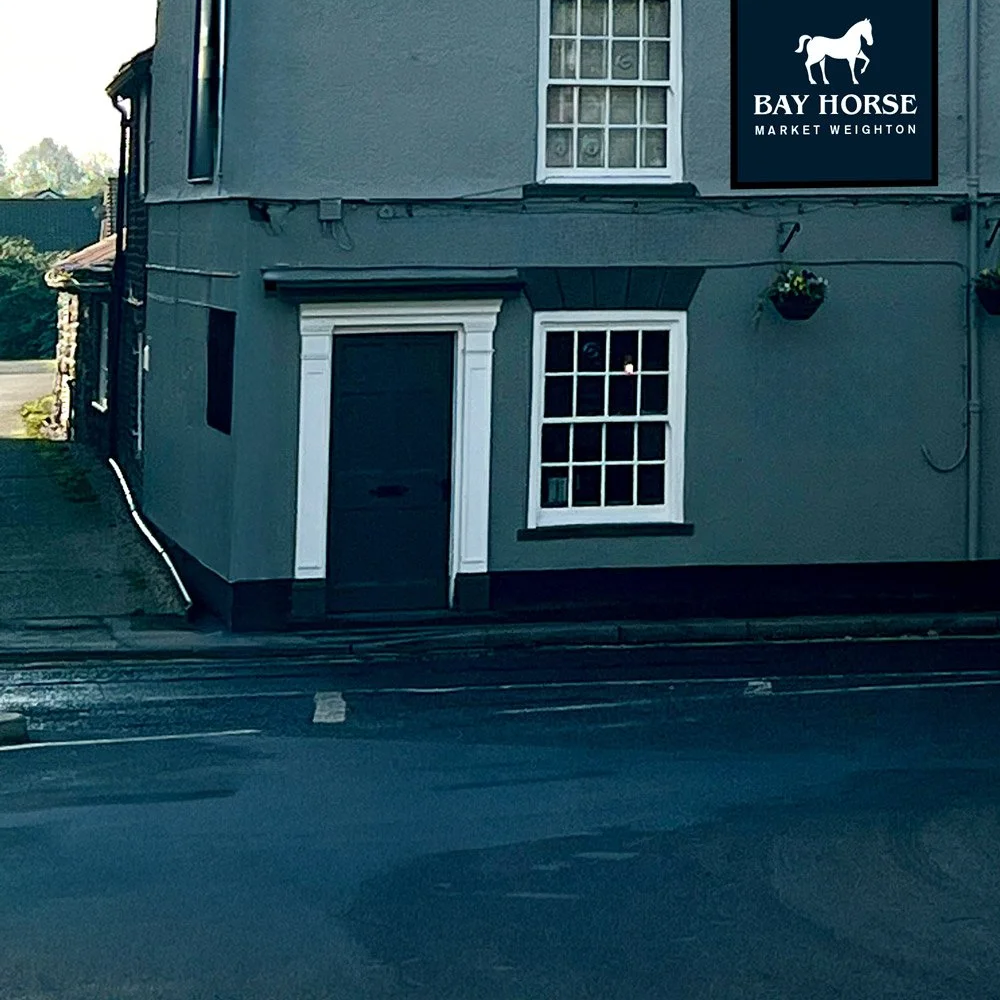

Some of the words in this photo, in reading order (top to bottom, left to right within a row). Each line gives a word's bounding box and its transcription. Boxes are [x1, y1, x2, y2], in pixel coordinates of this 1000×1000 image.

[753, 94, 810, 115] BAY
[818, 94, 918, 115] HORSE
[754, 124, 821, 136] MARKET
[829, 124, 916, 135] WEIGHTON
